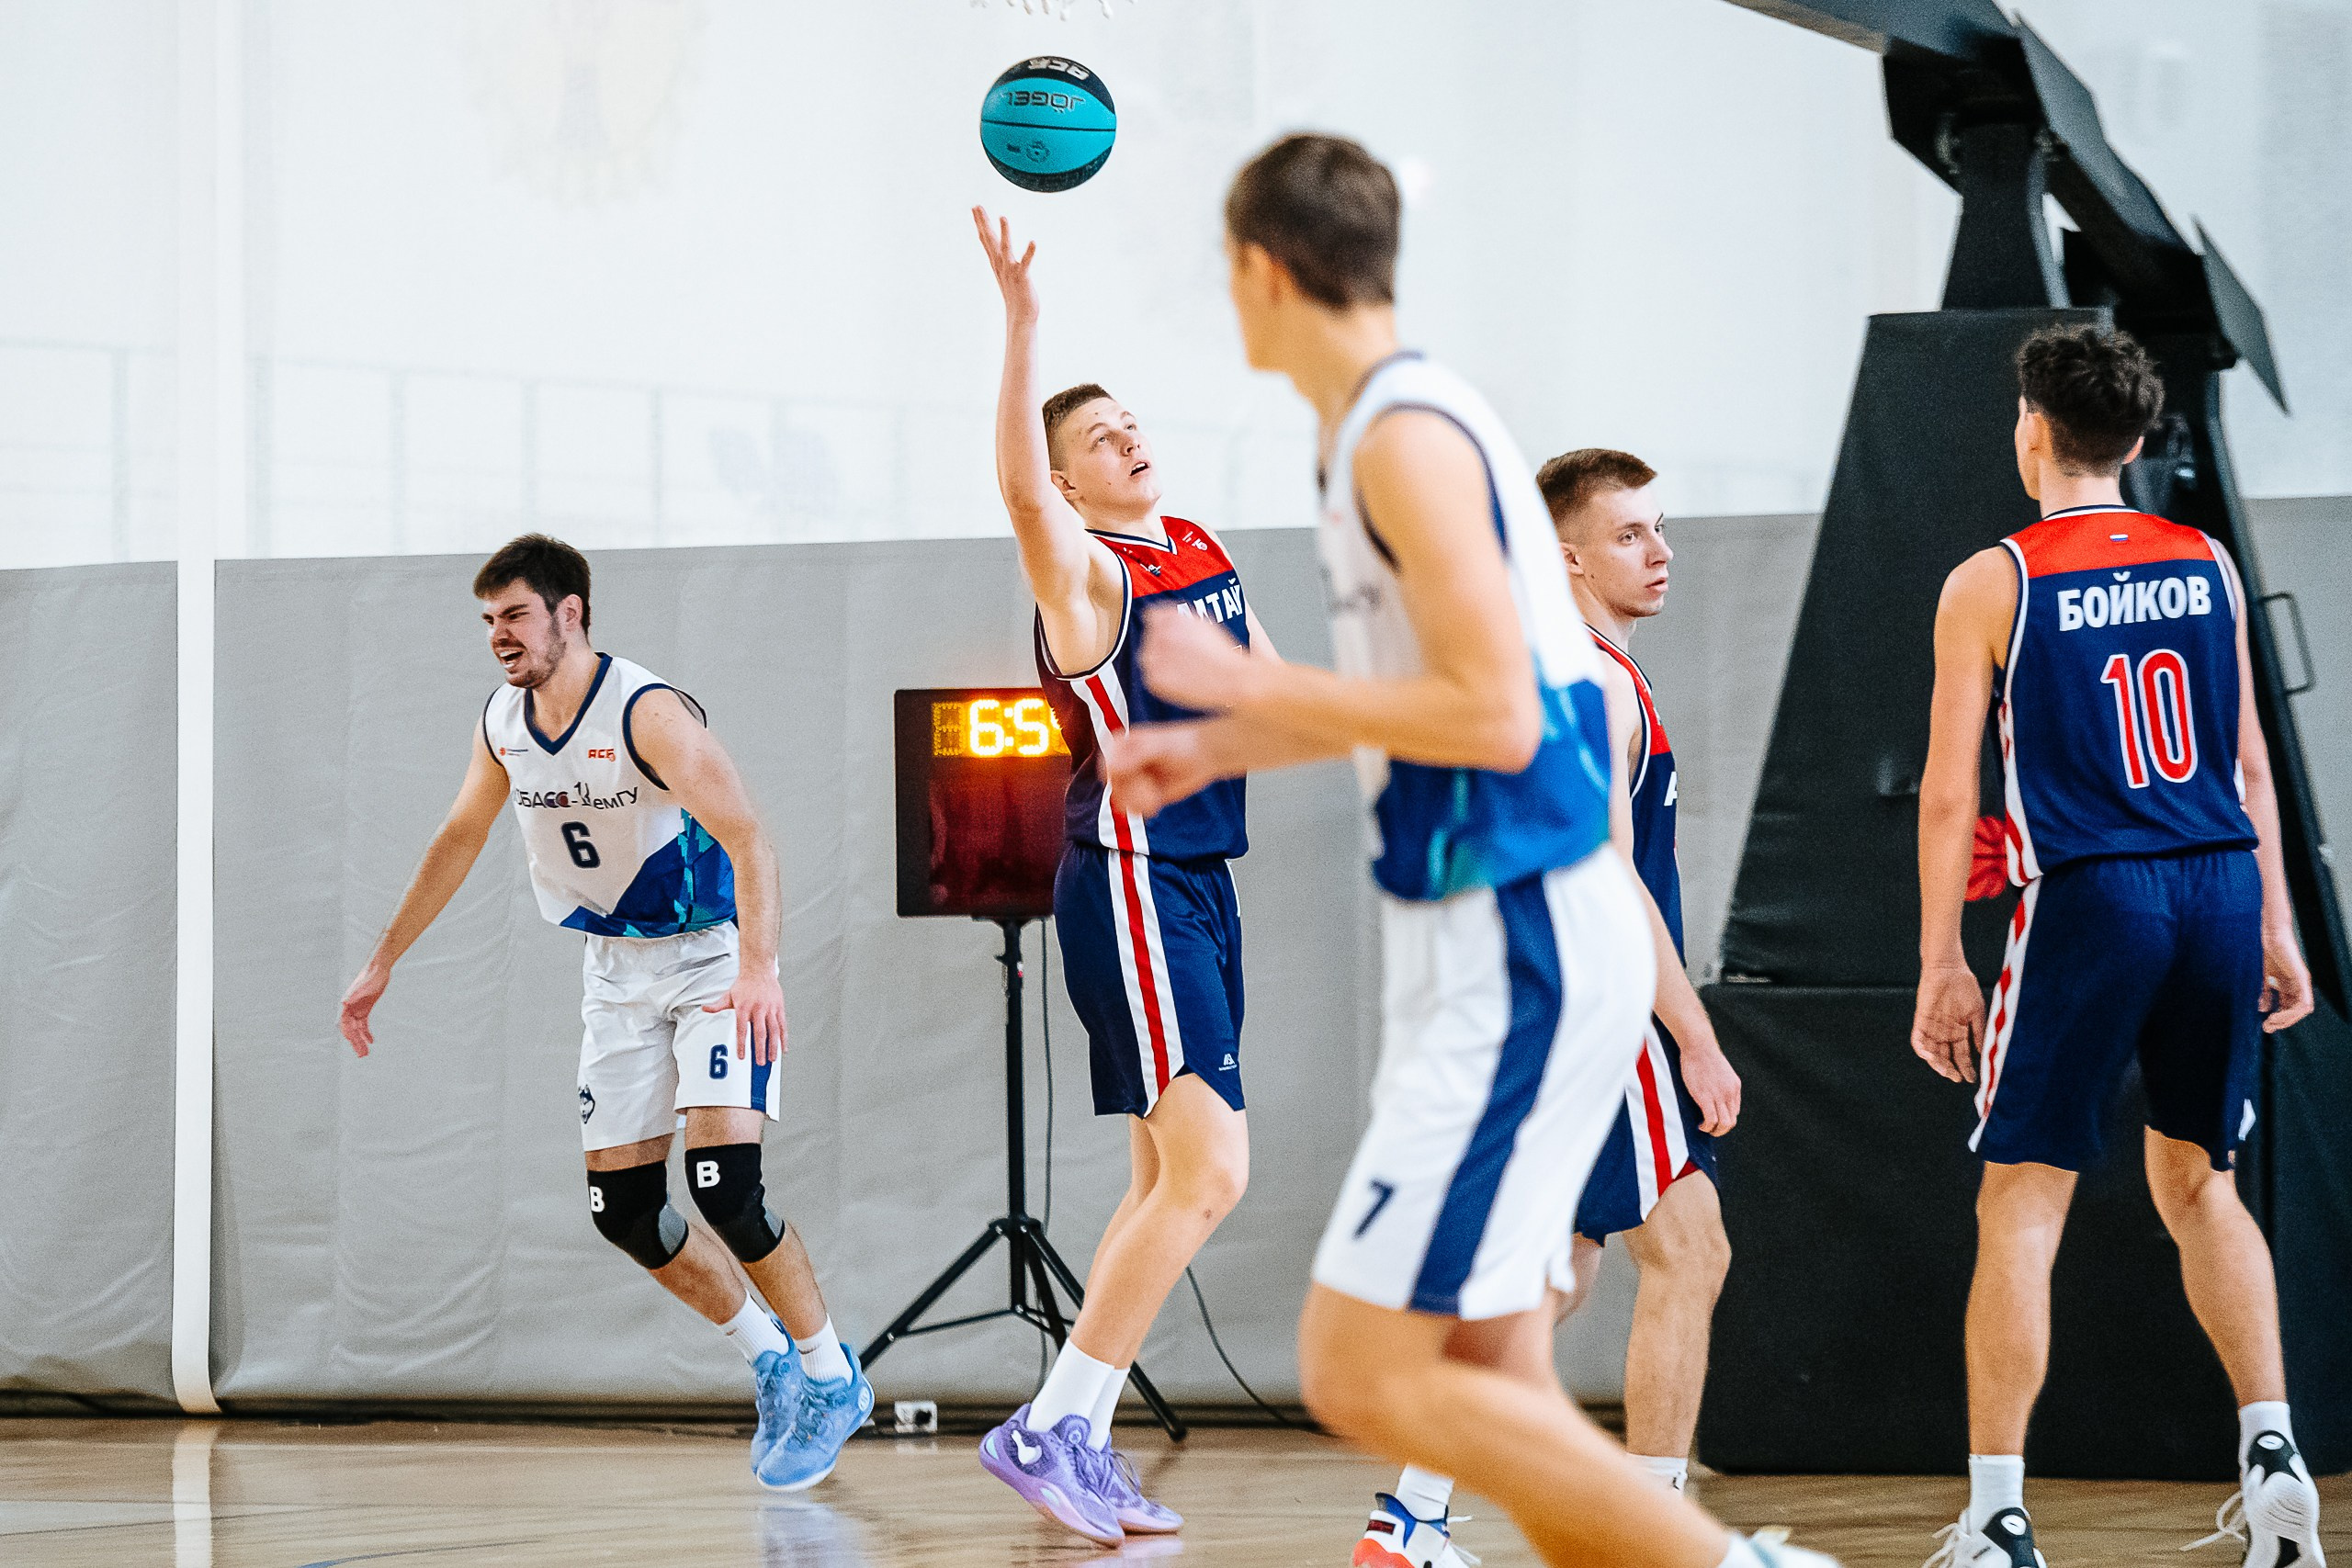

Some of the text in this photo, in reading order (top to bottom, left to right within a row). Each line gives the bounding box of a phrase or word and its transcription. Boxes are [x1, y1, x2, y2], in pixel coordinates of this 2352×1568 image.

[2057, 570, 2212, 631] БОЙКОВ
[969, 698, 1061, 757] 6:5
[2100, 649, 2199, 788] 10
[560, 821, 601, 868] 6
[708, 1043, 729, 1079] 6
[589, 1186, 605, 1213] B
[696, 1160, 721, 1188] B
[1352, 1179, 1396, 1239] 7
